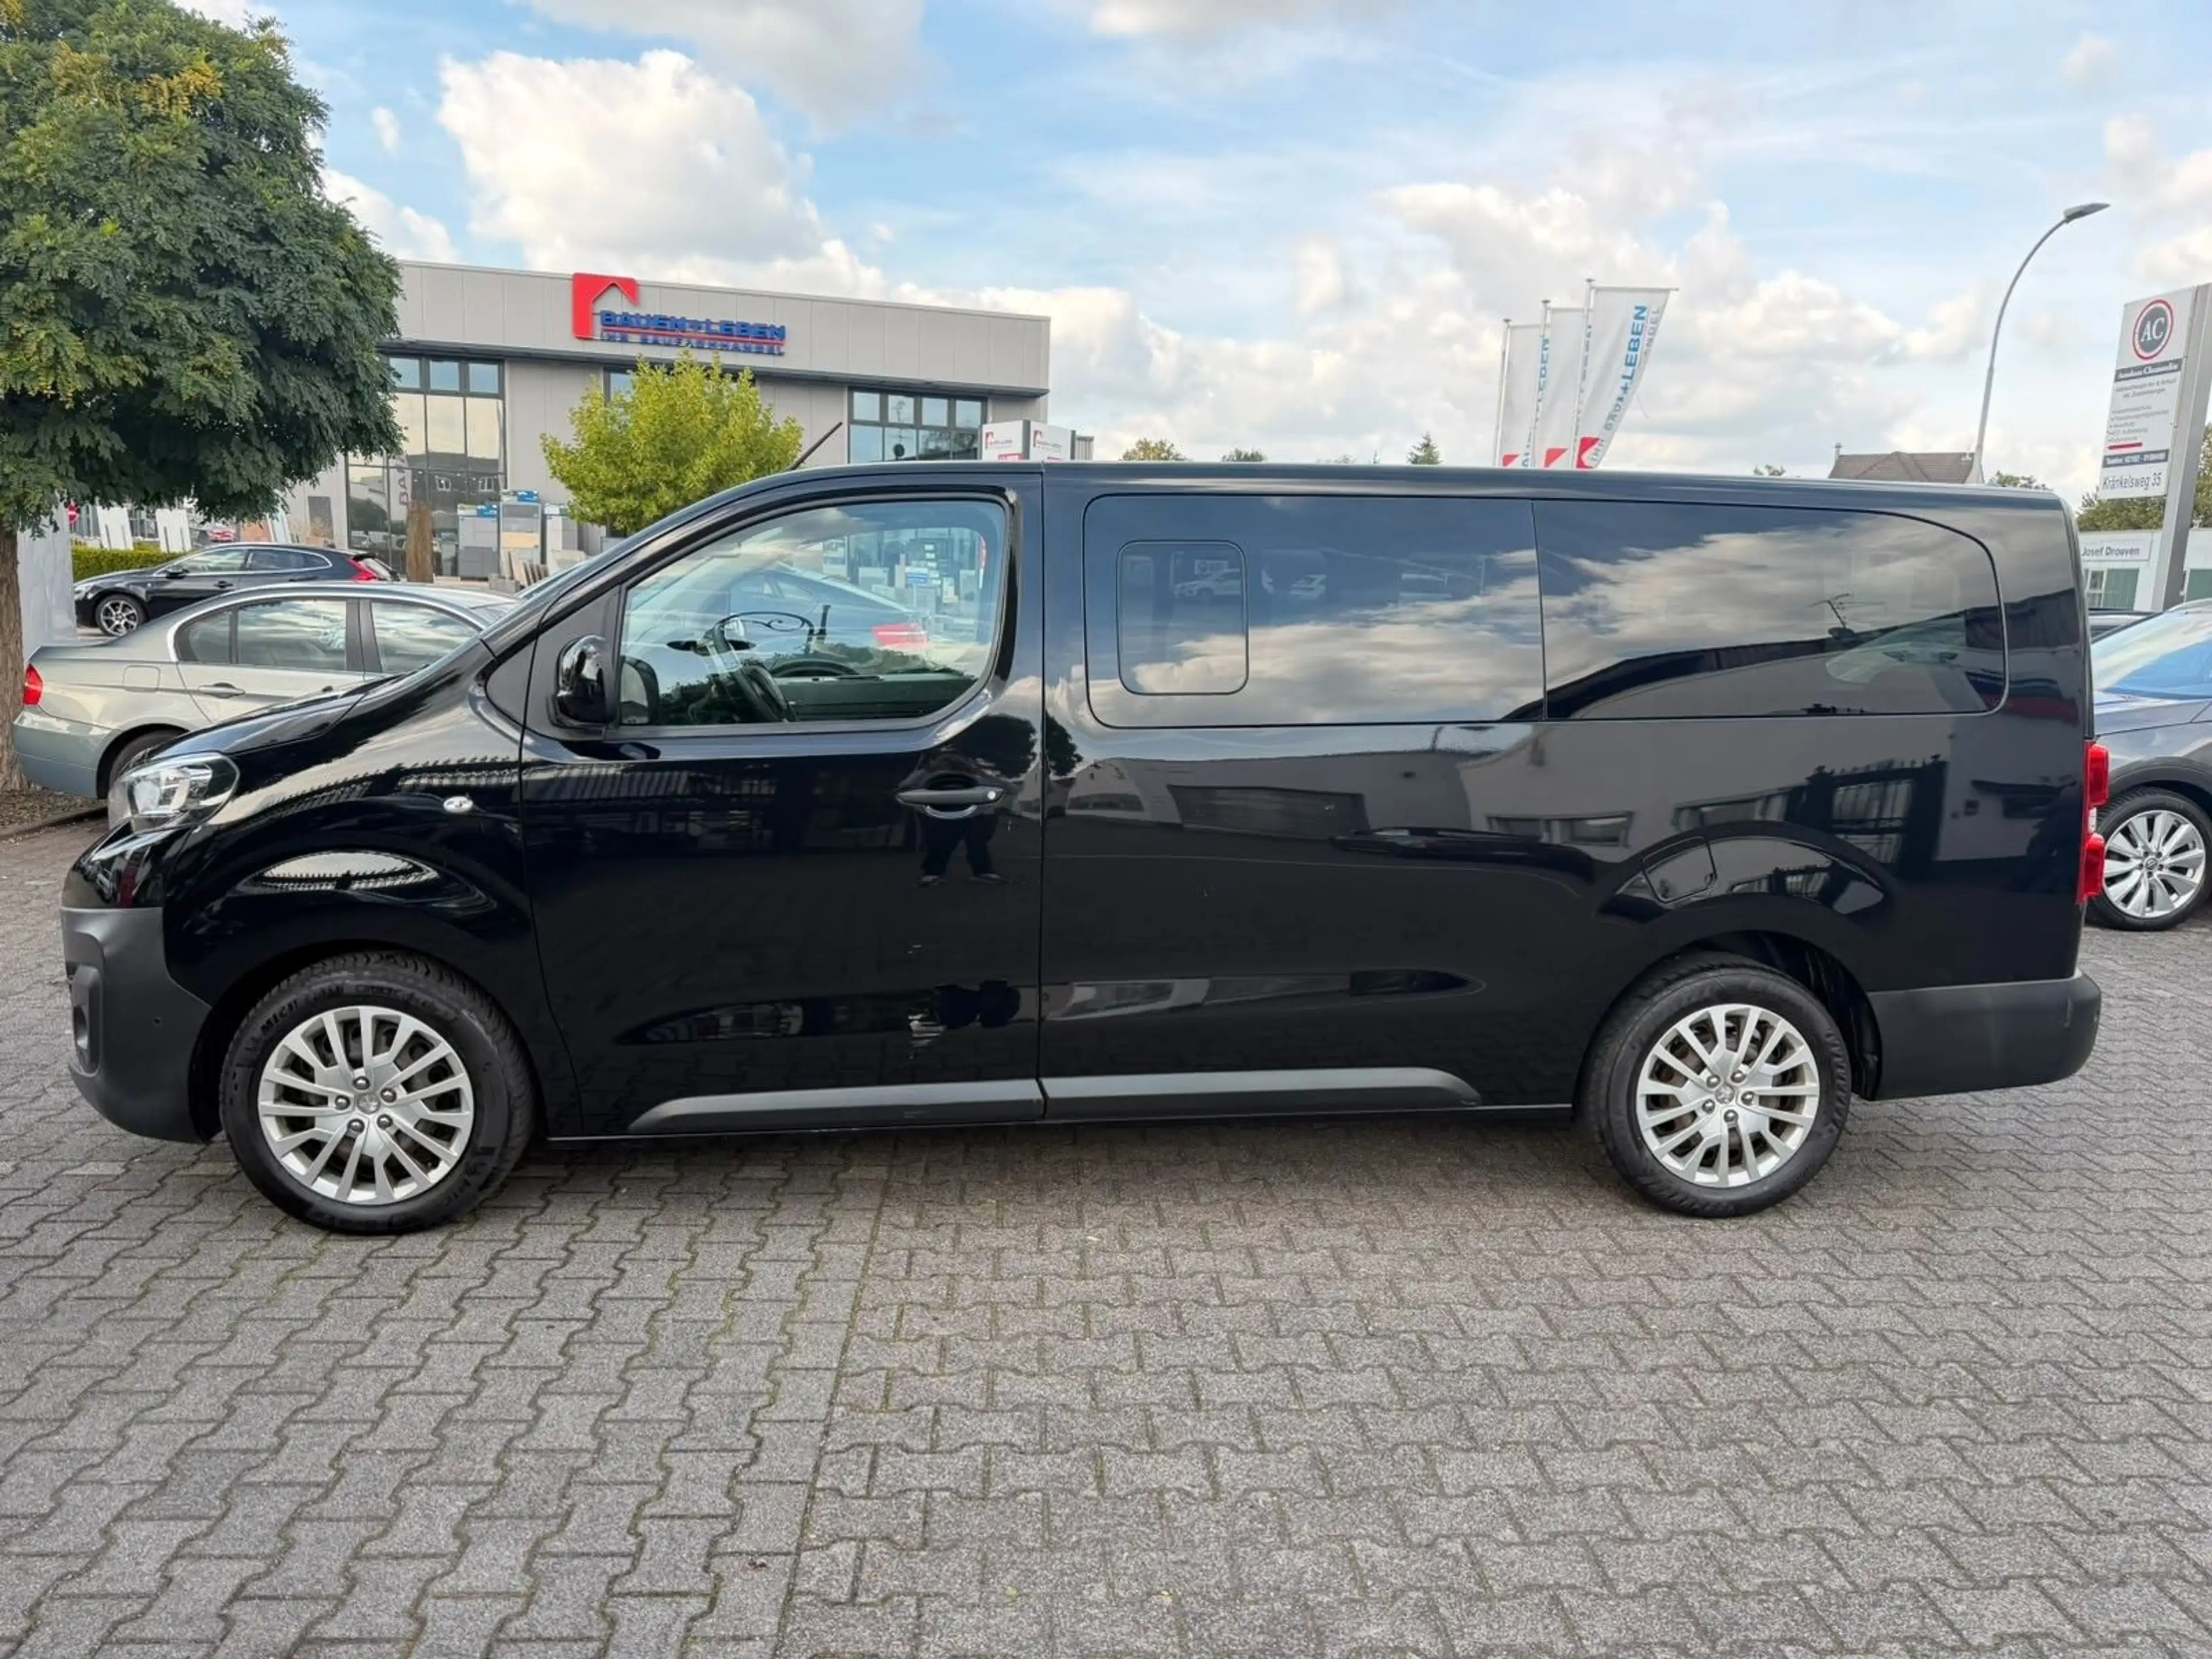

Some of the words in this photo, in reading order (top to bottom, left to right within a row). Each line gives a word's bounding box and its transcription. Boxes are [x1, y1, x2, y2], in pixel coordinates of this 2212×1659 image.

[2141, 317, 2165, 342] AC
[2152, 472, 2162, 486] 35
[2082, 546, 2103, 556] Josef
